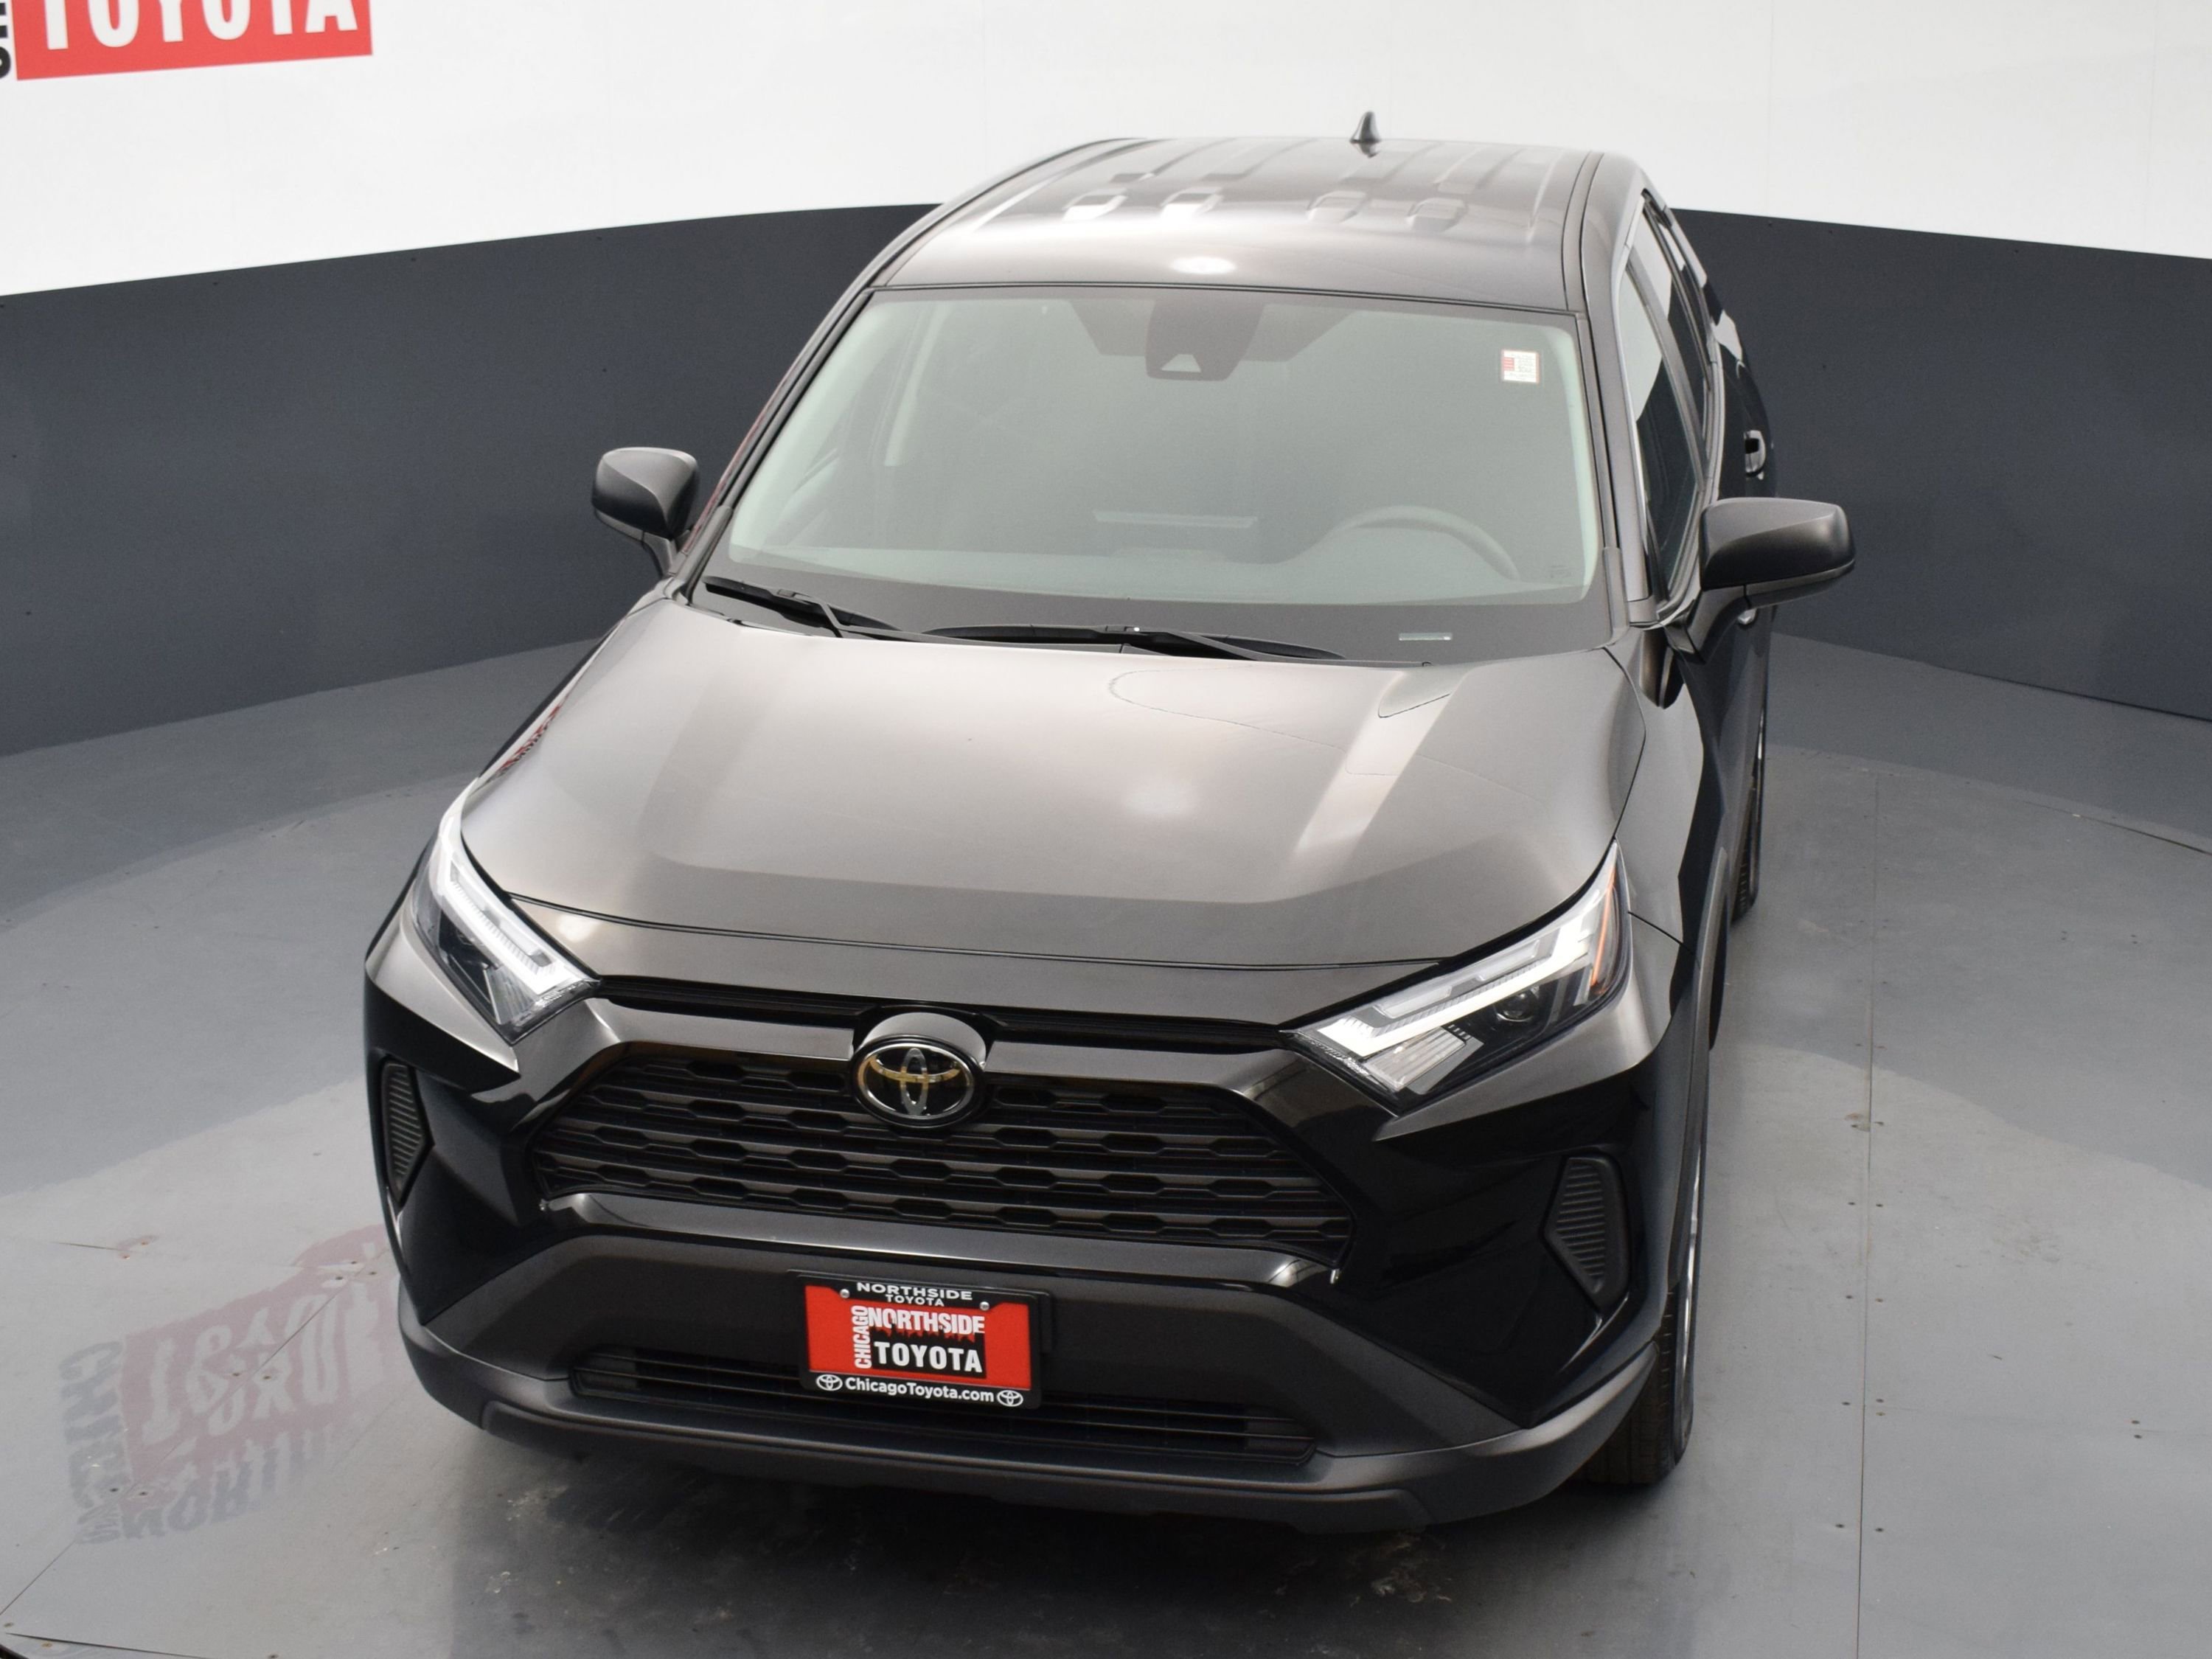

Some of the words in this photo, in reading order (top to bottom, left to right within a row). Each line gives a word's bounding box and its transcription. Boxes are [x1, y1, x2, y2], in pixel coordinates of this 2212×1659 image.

[856, 1282, 973, 1301] NORTHSIDE
[886, 1294, 945, 1307] TOYOTA
[868, 1307, 985, 1335] NORTHSIDE
[851, 1305, 872, 1369] CHICAGO
[874, 1341, 983, 1372] TOYOTA
[845, 1377, 995, 1402] ChicagoToyota.com
